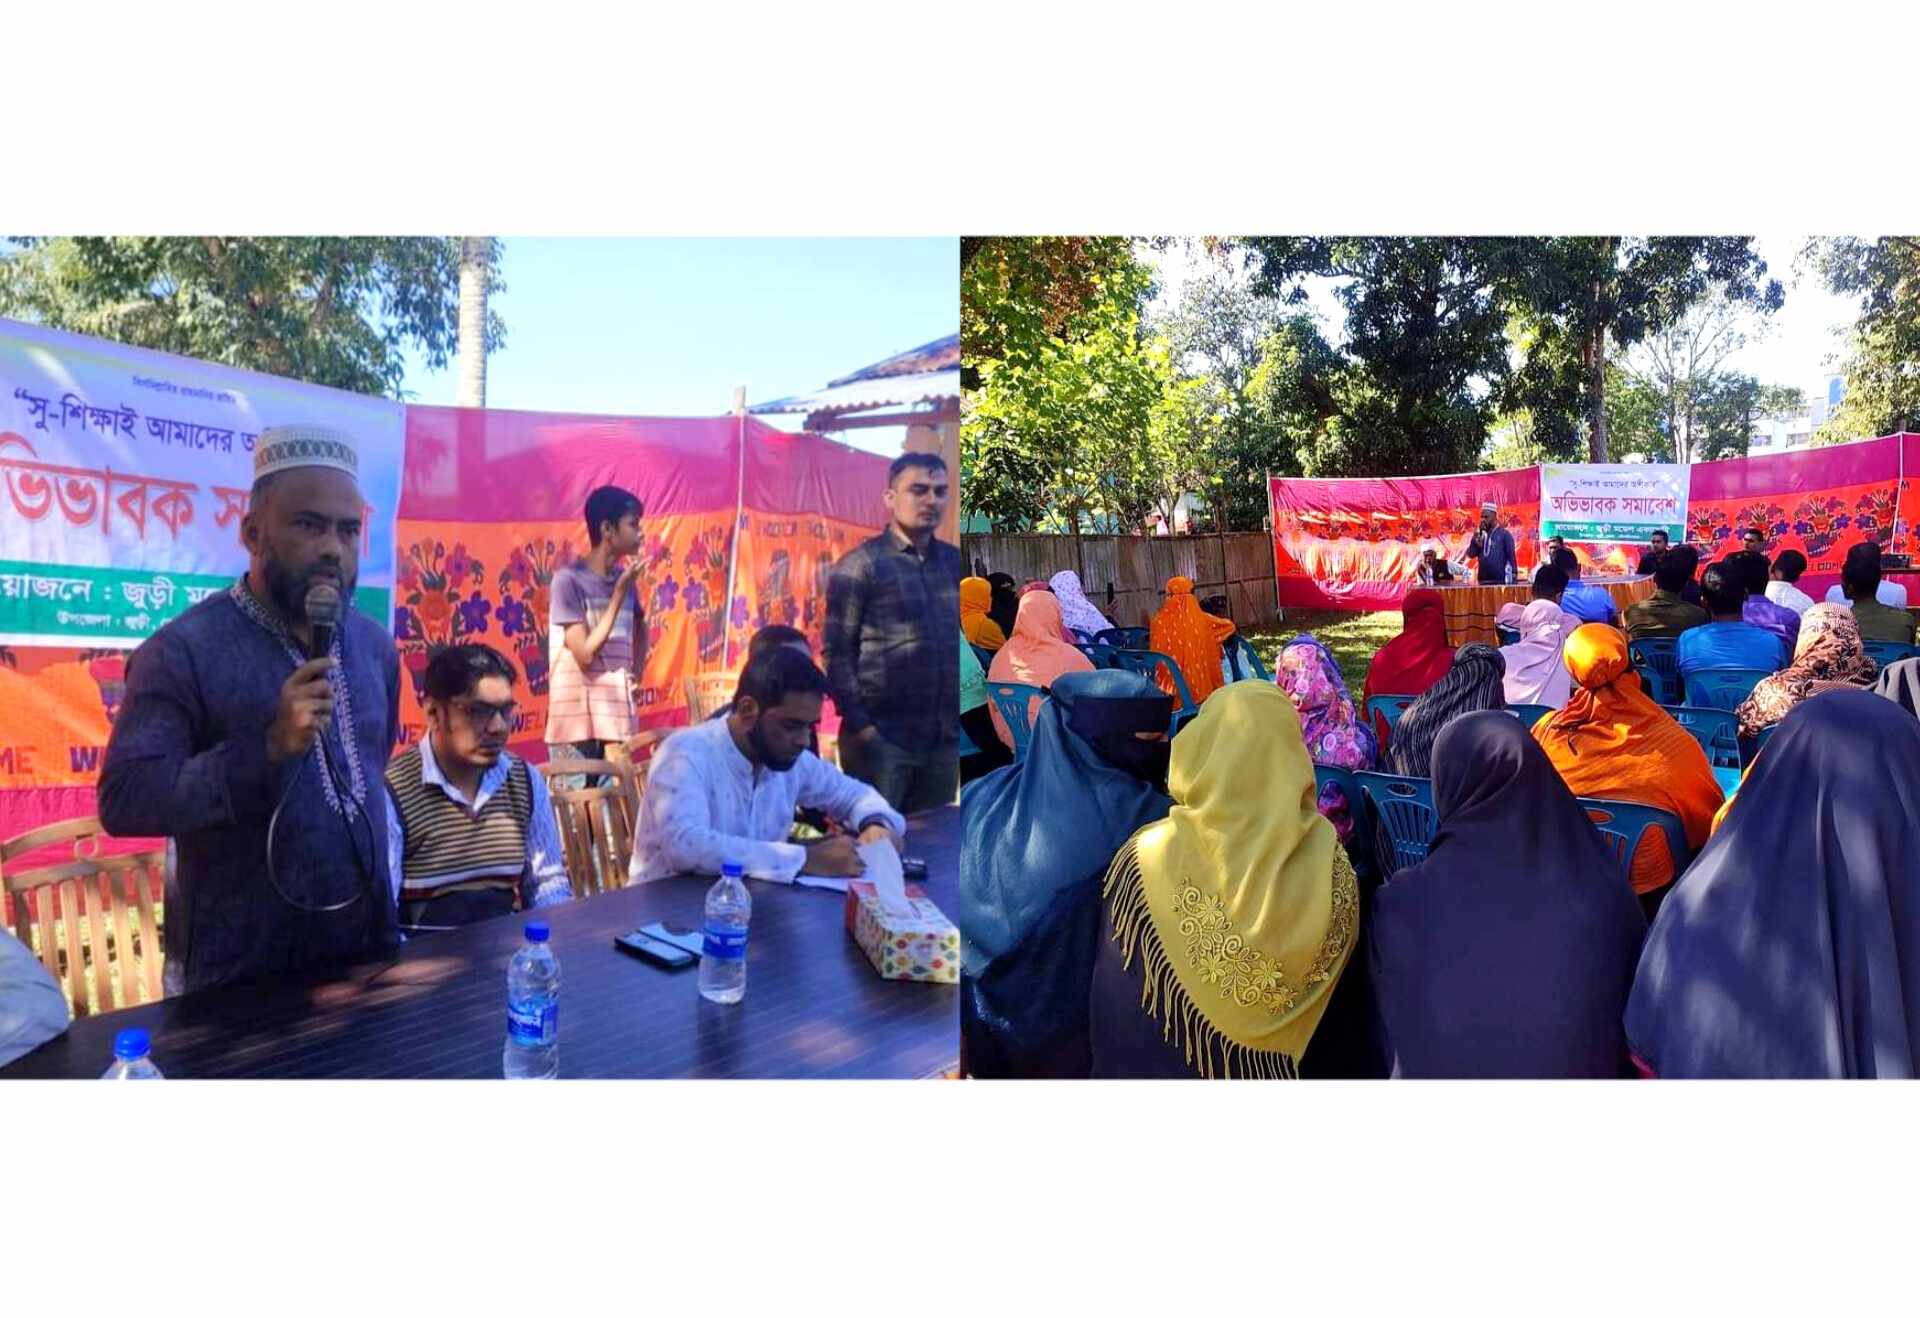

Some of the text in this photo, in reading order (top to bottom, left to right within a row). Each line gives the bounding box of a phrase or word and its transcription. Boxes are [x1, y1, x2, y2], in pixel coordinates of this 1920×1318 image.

[146, 416, 235, 453] আমাদের
[0, 431, 198, 543] ভিভাবক
[1550, 490, 1677, 515] অভিভাবক সমাবেশ
[121, 576, 176, 610] জুড়ী
